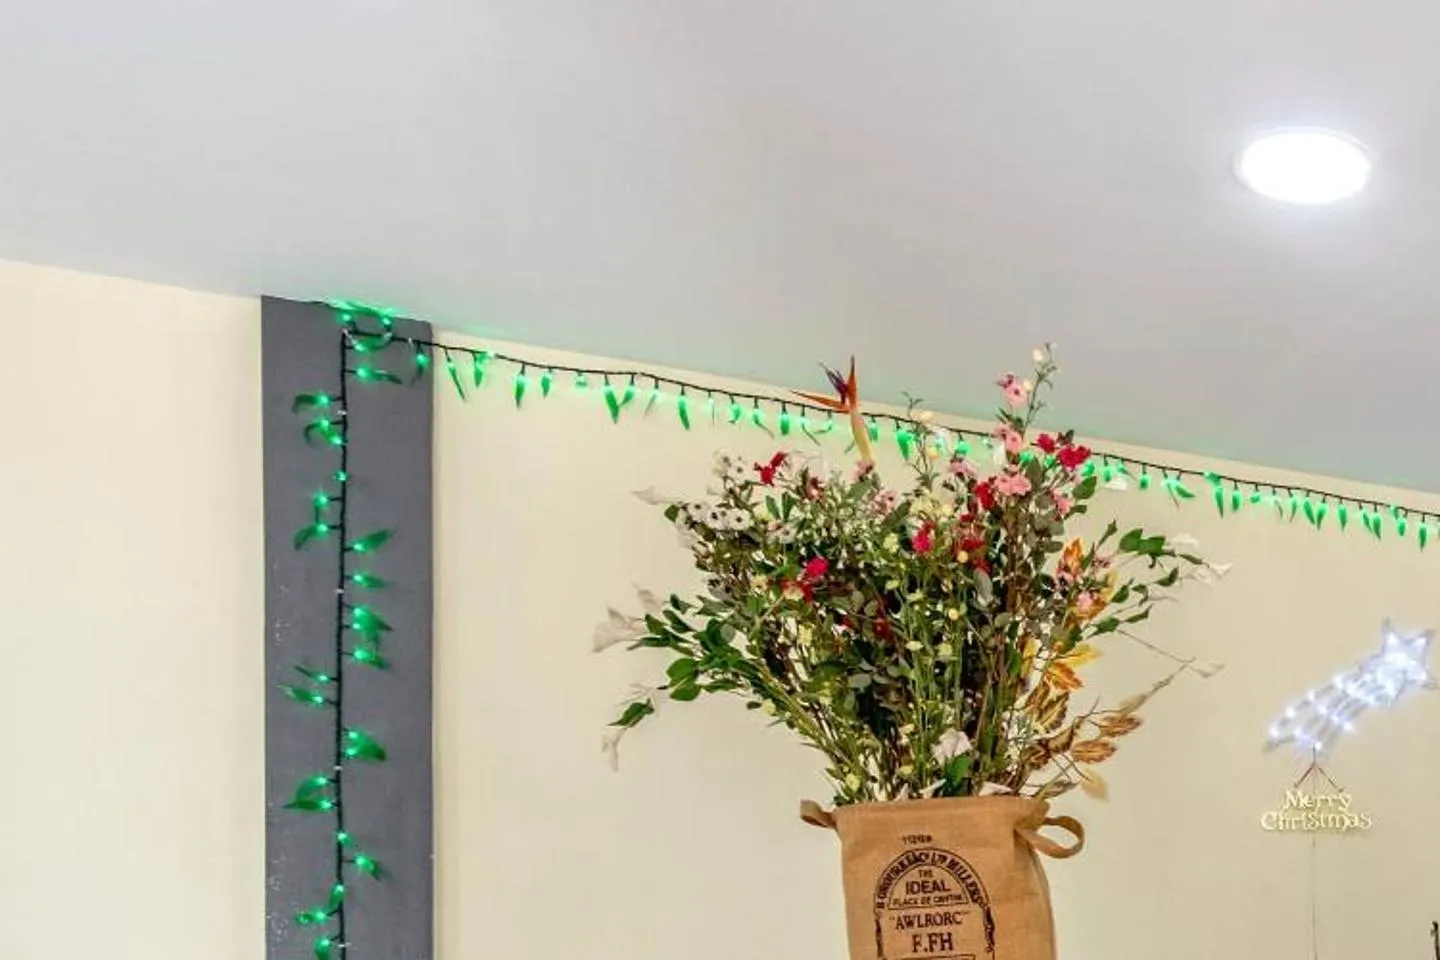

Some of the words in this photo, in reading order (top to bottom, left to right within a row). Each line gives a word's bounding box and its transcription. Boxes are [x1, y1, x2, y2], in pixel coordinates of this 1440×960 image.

[1283, 790, 1352, 812] Merry
[1260, 810, 1373, 831] Christmas
[906, 880, 952, 895] IDEAL
[912, 932, 954, 953] F.FH
